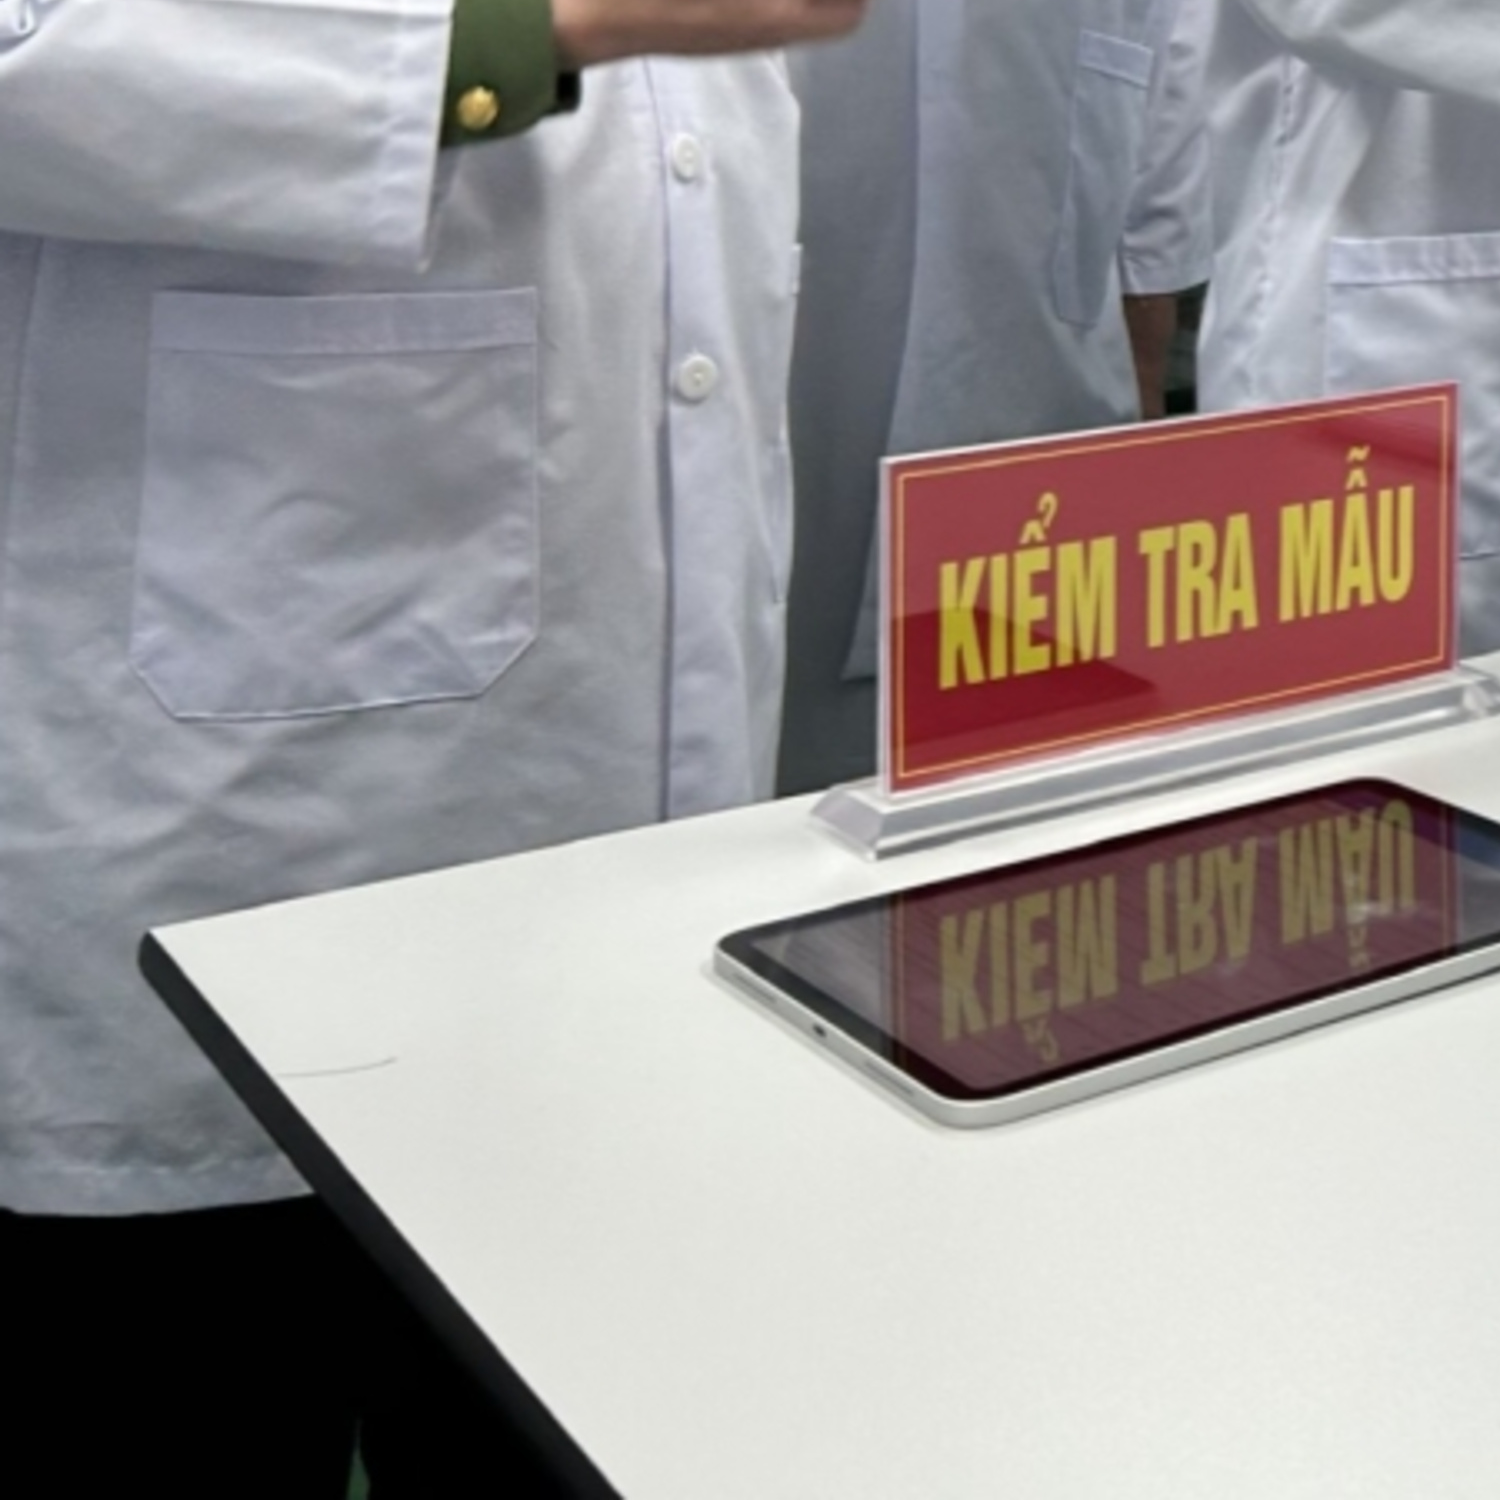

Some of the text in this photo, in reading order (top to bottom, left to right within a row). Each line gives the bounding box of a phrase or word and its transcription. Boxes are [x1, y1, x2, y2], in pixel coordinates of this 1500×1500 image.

[938, 445, 1415, 690] KIỂM TRA MẪU
